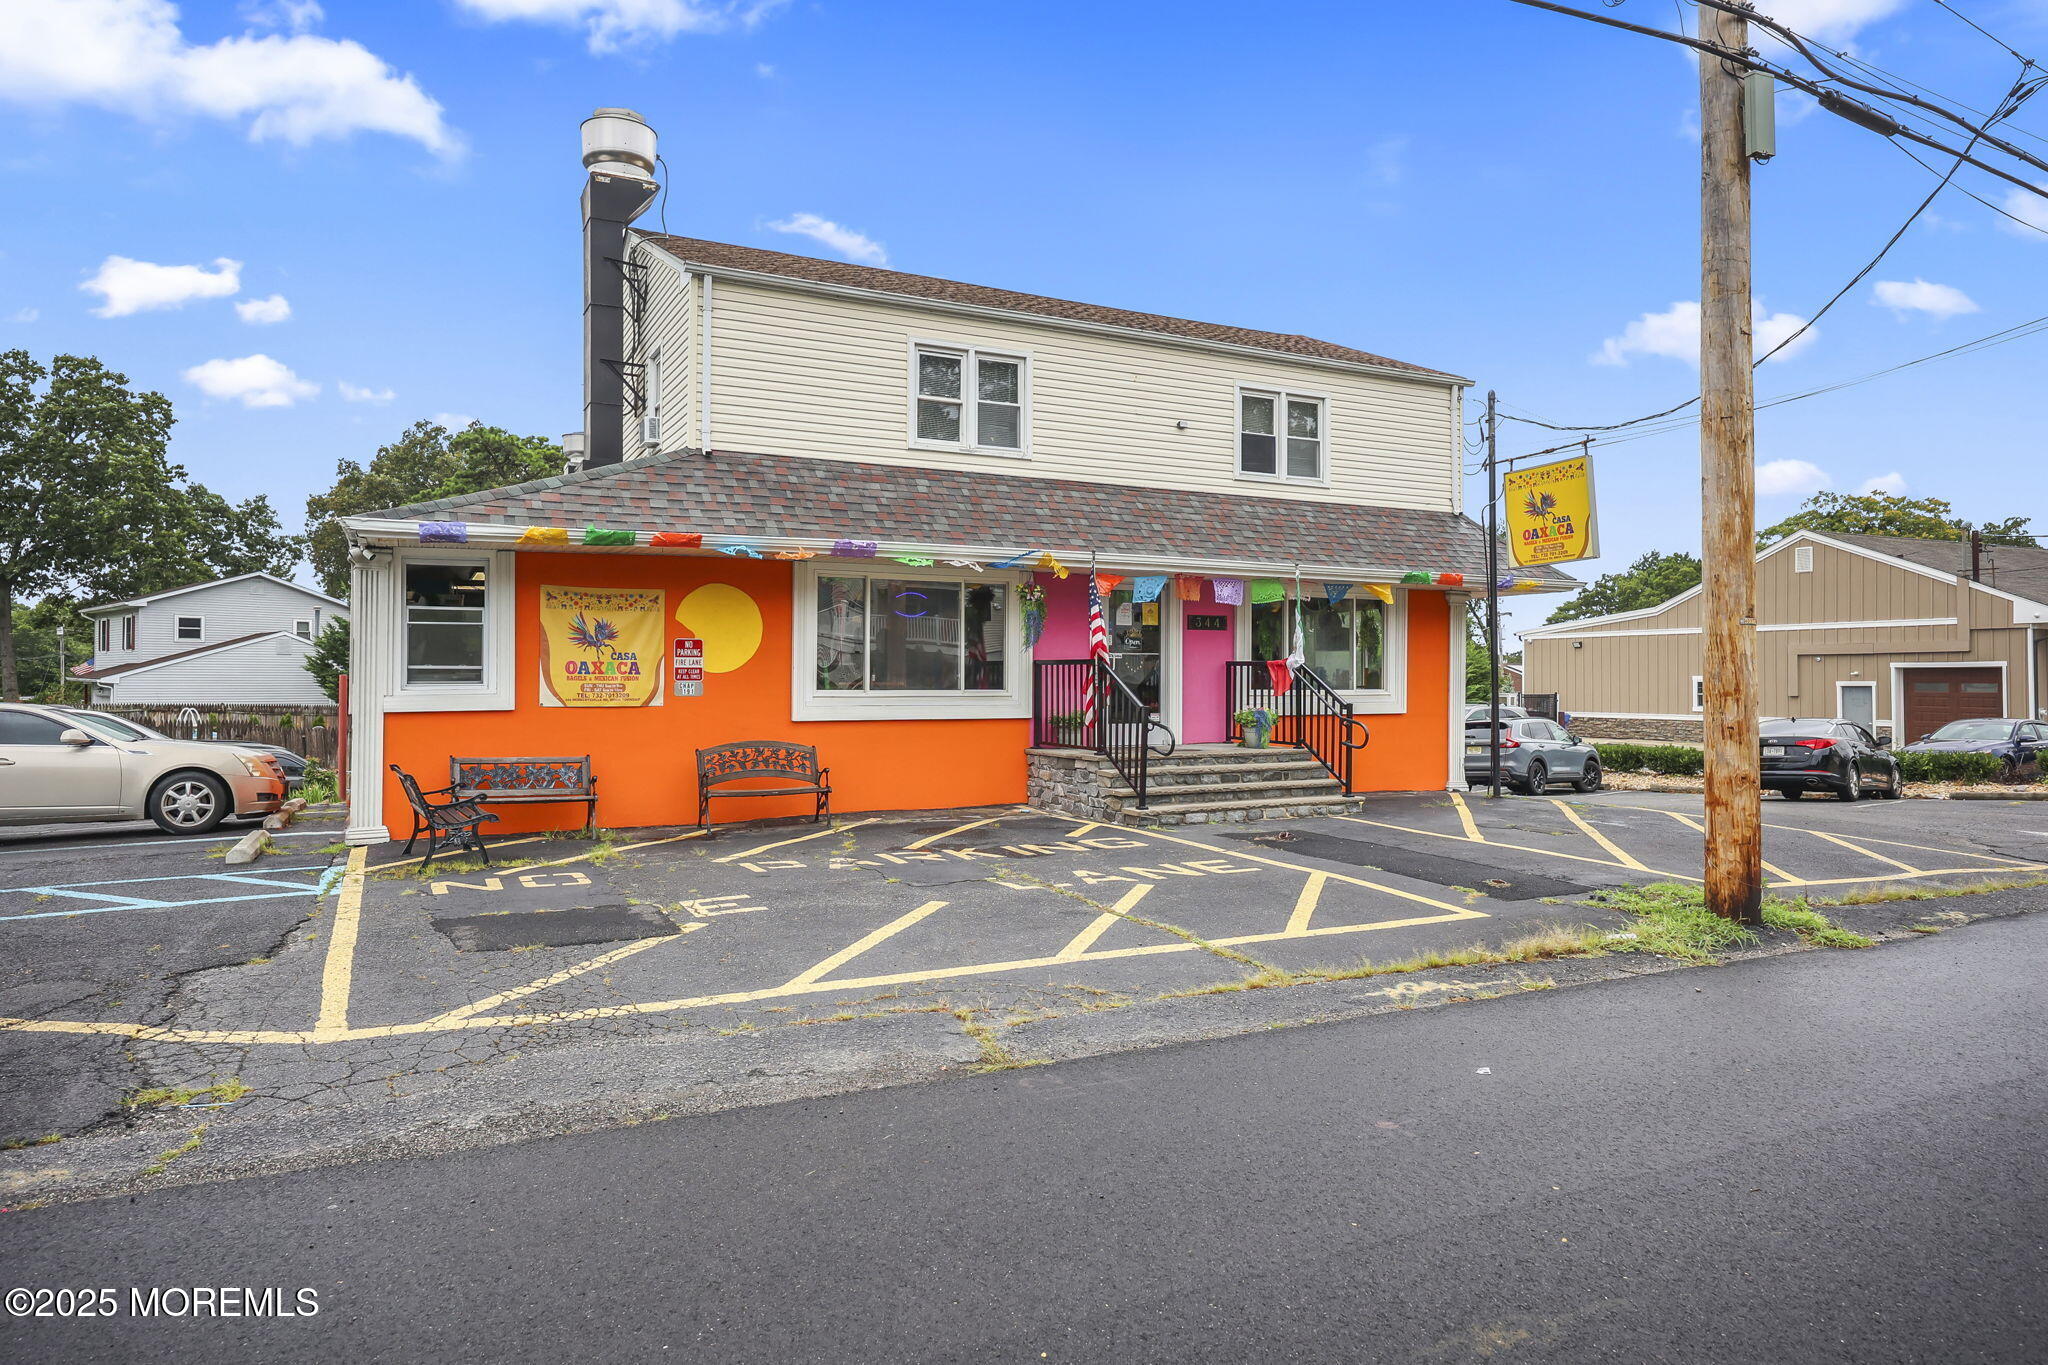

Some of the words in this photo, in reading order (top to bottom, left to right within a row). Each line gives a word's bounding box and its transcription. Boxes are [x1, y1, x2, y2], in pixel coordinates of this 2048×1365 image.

[1552, 515, 1571, 524] CASA
[1523, 523, 1574, 540] OAXACA
[1195, 617, 1220, 628] 344
[684, 640, 694, 649] NO
[1125, 638, 1141, 647] Open
[610, 652, 637, 661] CASA
[676, 648, 701, 657] PARKING
[564, 660, 641, 675] OAXACA
[986, 859, 1263, 890] LANE
[430, 872, 592, 895] NO
